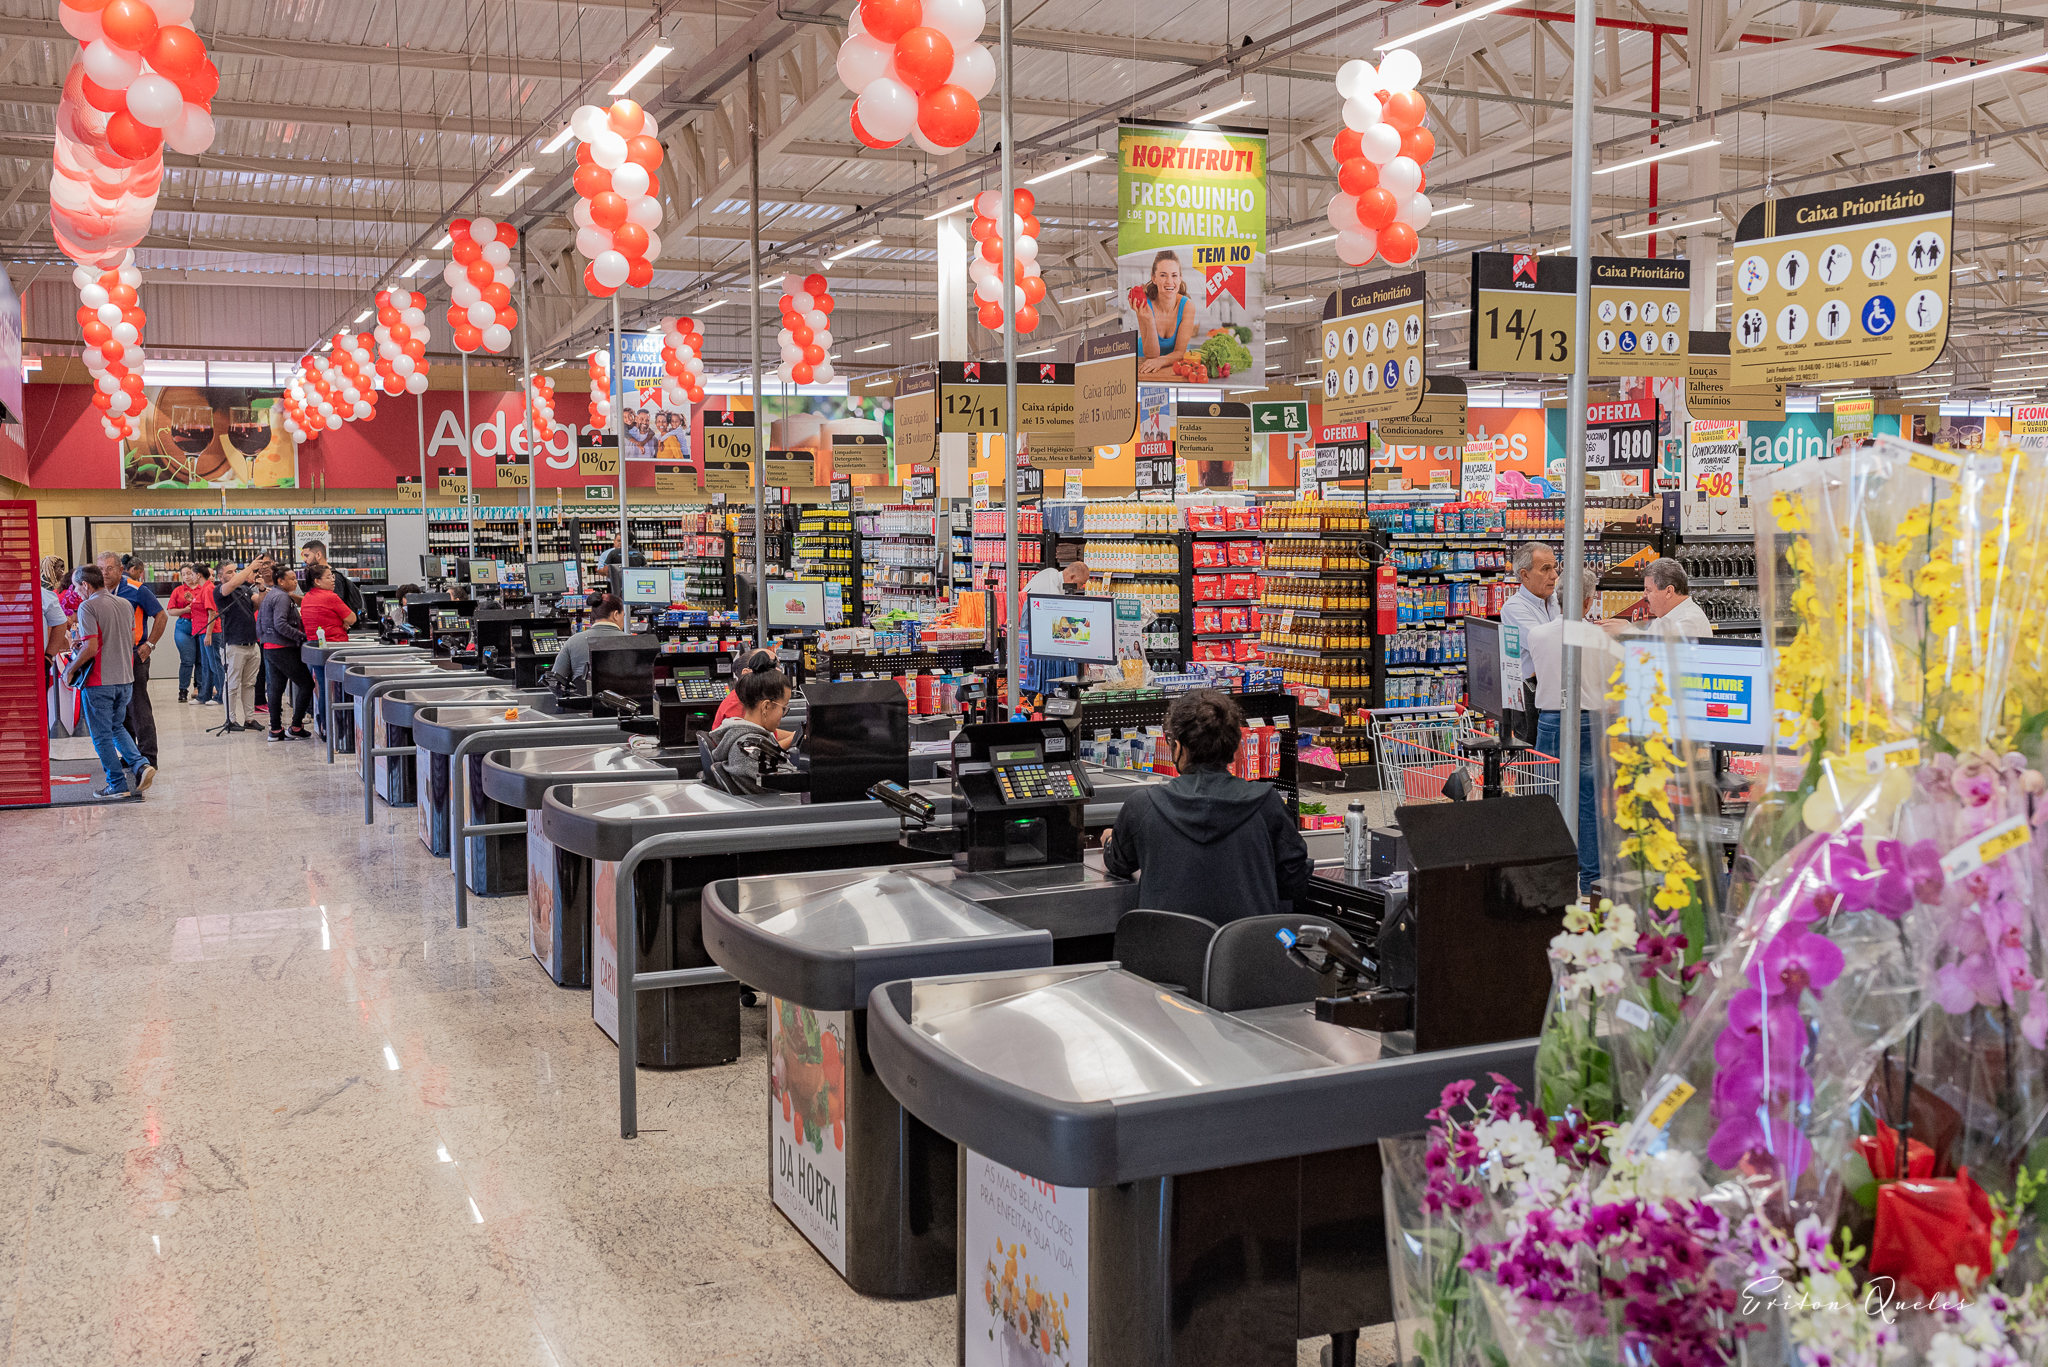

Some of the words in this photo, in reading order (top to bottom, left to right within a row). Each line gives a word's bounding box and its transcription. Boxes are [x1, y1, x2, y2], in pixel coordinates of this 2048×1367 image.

[1132, 145, 1253, 172] HORTIFRUTI
[1131, 182, 1254, 212] FRESQUINHO
[1796, 205, 1838, 224] Caixa
[1842, 190, 1925, 218] Prioritário
[1127, 210, 1131, 219] E
[1133, 210, 1142, 219] DE
[1145, 210, 1257, 240] PRIMEIRA...
[1197, 247, 1225, 263] TEM
[1230, 245, 1250, 261] NO
[1513, 255, 1530, 275] EPA
[1597, 265, 1627, 277] Caixa
[1630, 266, 1685, 280] Prioritário
[1206, 265, 1234, 296] EPA
[1352, 294, 1371, 307] Caixa
[1373, 285, 1411, 303] Prioritário
[1486, 307, 1568, 361] 14/13
[621, 338, 628, 352] O
[1094, 344, 1112, 356] Prezado
[1113, 341, 1131, 353] Cliente,
[639, 352, 657, 362] VOCÊ
[964, 362, 975, 375] EPA
[1040, 364, 1050, 376] EPA
[1689, 367, 1717, 378] Louças
[907, 380, 918, 391] Prezado
[1083, 384, 1101, 400] Caixa
[1104, 381, 1127, 401] rápido
[1689, 382, 1723, 391] Talheres
[640, 387, 655, 402] EPA
[1689, 395, 1730, 405] Alumínios
[945, 395, 999, 426] 12/11
[1022, 403, 1044, 411] Caixa
[1046, 403, 1074, 414] rápido
[1079, 410, 1090, 424] até
[1092, 408, 1100, 422] 15
[1102, 405, 1131, 421] volumes
[1587, 403, 1641, 422] OFERTA
[1838, 403, 1870, 412] HORTIFRUTI
[900, 414, 913, 426] Caixa
[914, 412, 929, 427] rápido
[1046, 417, 1074, 425] volumes
[1694, 420, 1734, 431] ECONOMIA
[1837, 414, 1870, 423] FRESQUINHO
[906, 433, 912, 444] 15
[912, 431, 932, 444] volumes
[1323, 426, 1358, 441] OFERTA
[1381, 426, 1443, 435] Condicionadores
[708, 434, 751, 457] 10/09
[1047, 446, 1073, 455] Higiênico
[1141, 443, 1167, 455] OFERTA
[1465, 442, 1493, 451] ECONOMIA
[1613, 430, 1651, 463] 19,80
[1692, 444, 1738, 458] CONDICIONADOR
[581, 452, 616, 471] 08/07
[1017, 455, 1029, 464] OFER
[1340, 447, 1365, 475] 29,80
[498, 468, 528, 485] 06/05
[1158, 462, 1172, 484] 8,90
[1464, 463, 1492, 475] MUÇARELA
[399, 486, 421, 498] 02/01
[441, 479, 466, 493] 04/03
[1713, 678, 1744, 692] LIVRE
[1713, 692, 1737, 700] CLIENTE
[780, 1135, 794, 1188] DA
[799, 1153, 838, 1232] HORTA
[984, 1163, 995, 1183] AS
[997, 1172, 1017, 1201] MAIS
[1020, 1189, 1043, 1222] BELAS
[1045, 1210, 1073, 1246] CORES
[799, 1201, 808, 1220] PRA
[810, 1213, 820, 1233] SUA
[981, 1184, 995, 1209] PRA
[997, 1198, 1032, 1239] ENFEITAR
[1034, 1227, 1051, 1256] SUA
